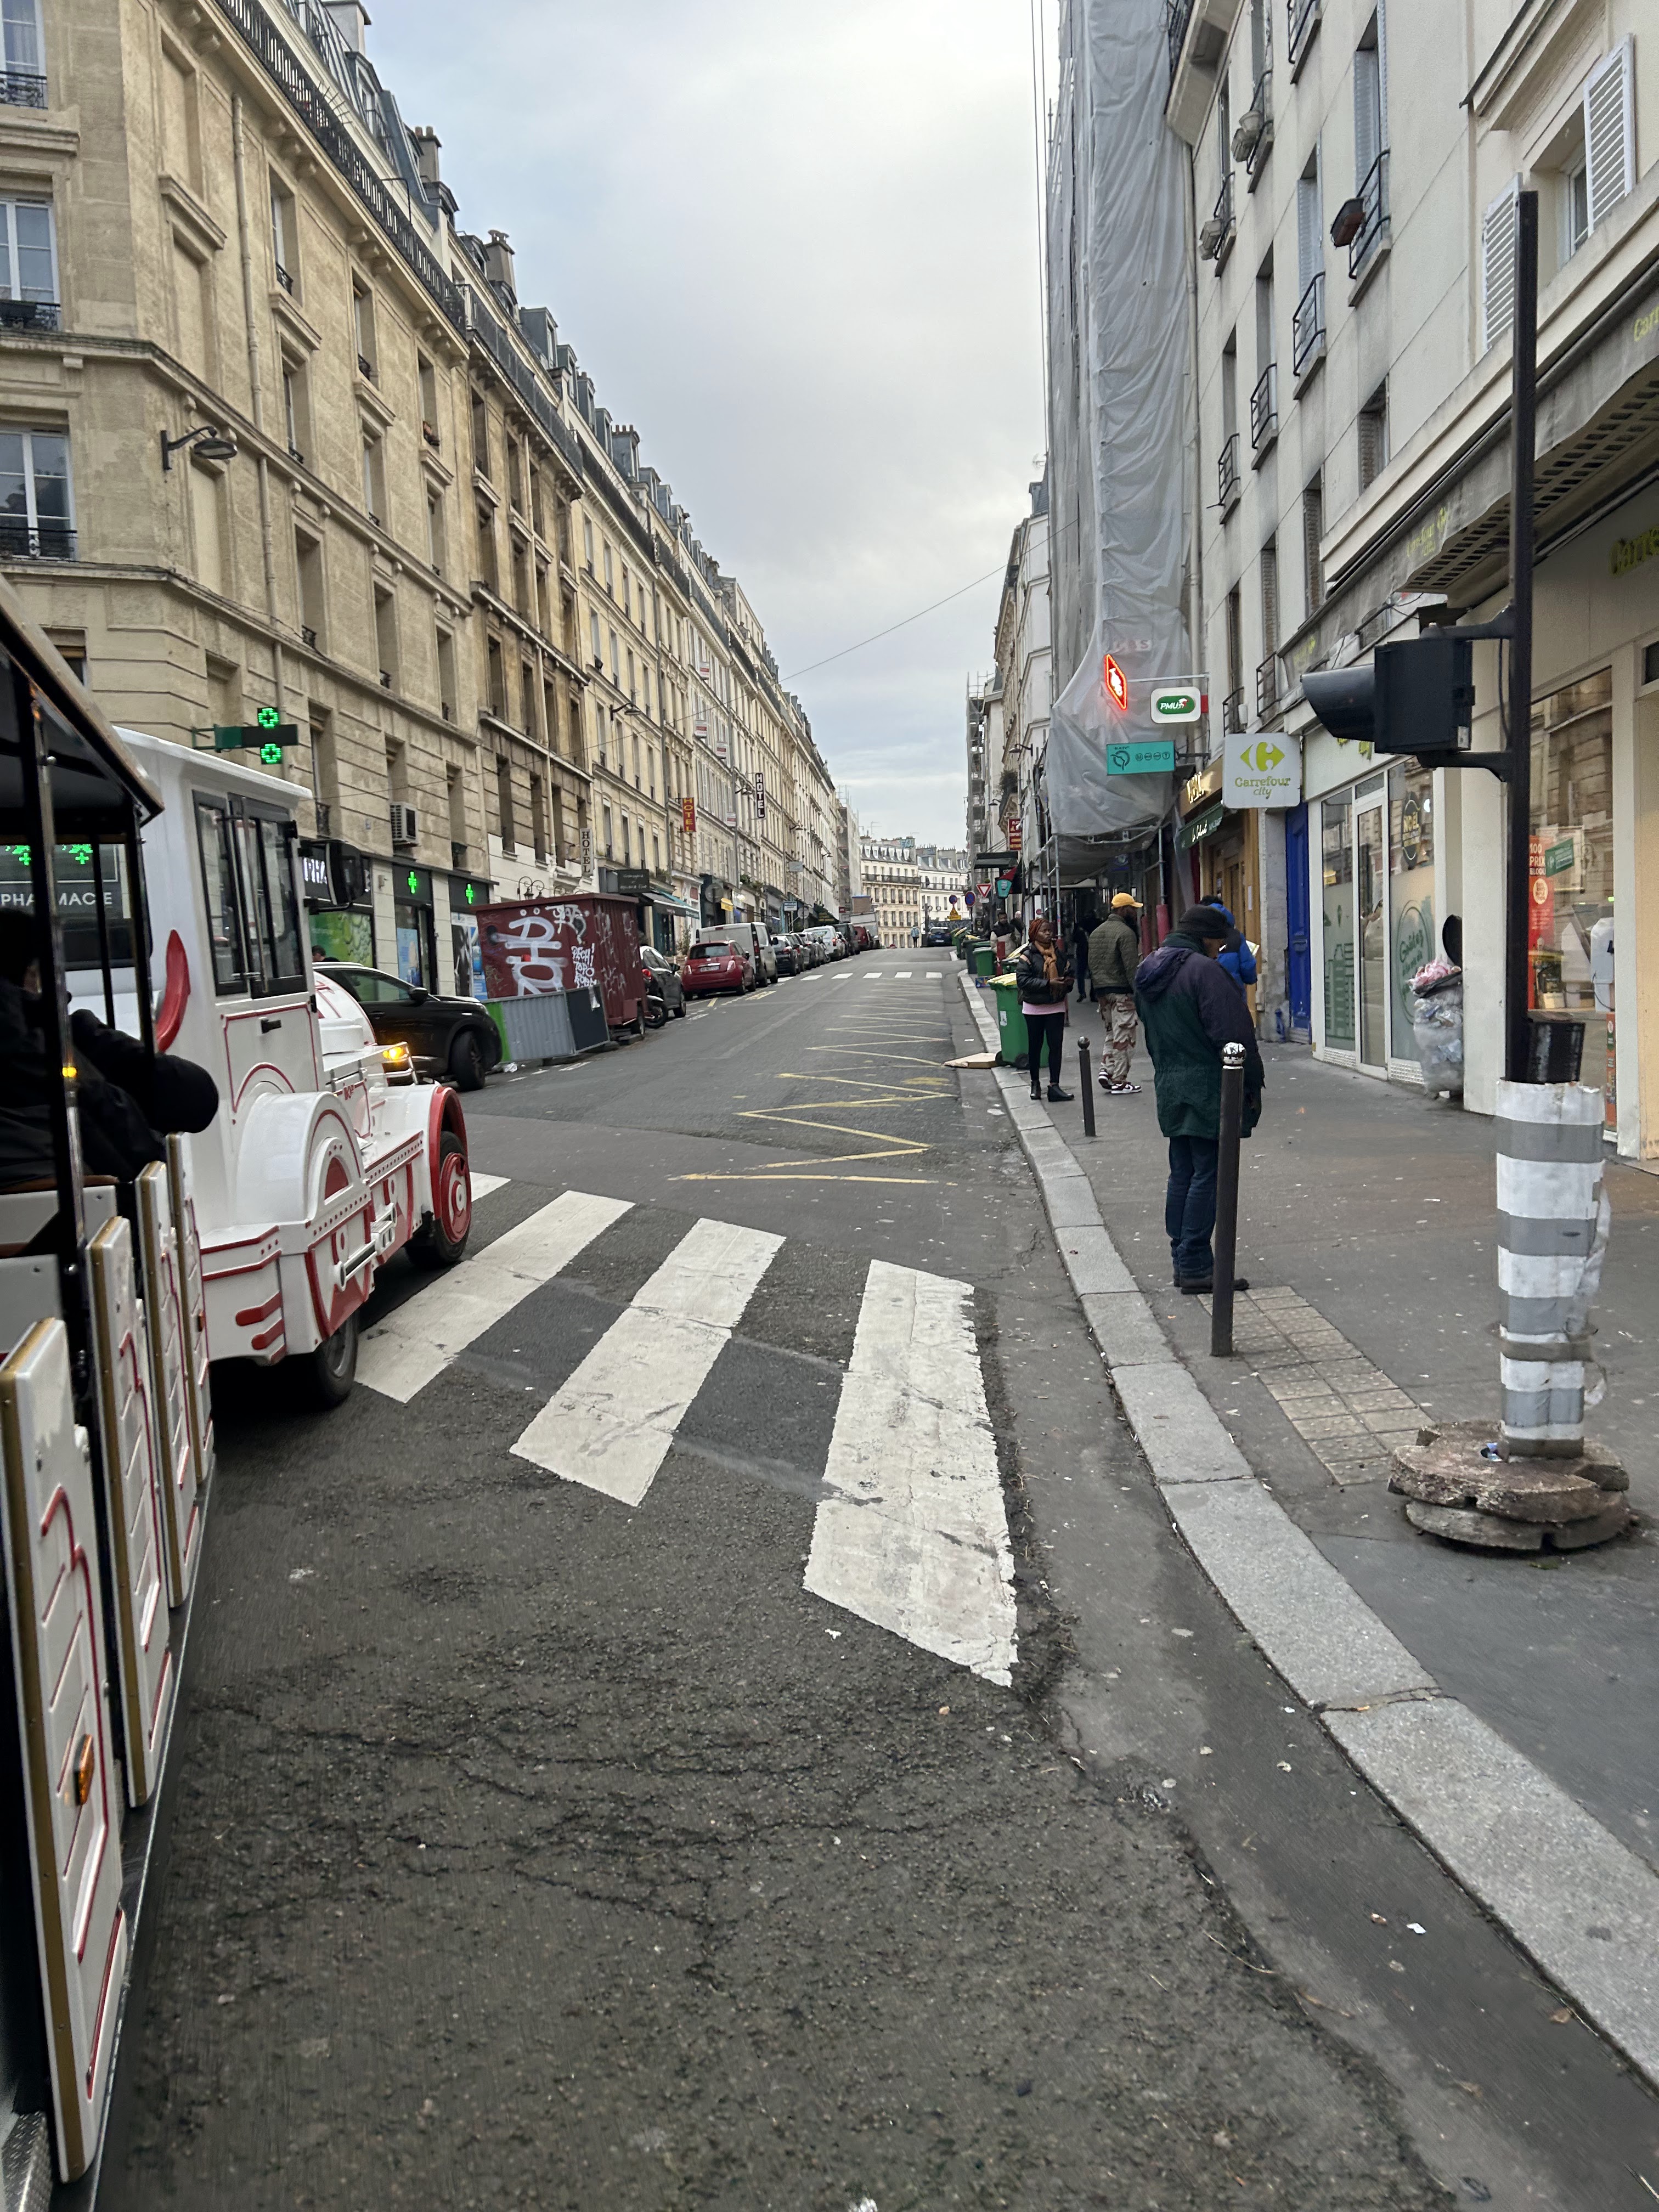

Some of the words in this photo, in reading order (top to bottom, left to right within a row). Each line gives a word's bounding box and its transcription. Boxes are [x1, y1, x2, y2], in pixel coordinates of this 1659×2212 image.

[1234, 776, 1291, 787] Carrefour
[756, 774, 765, 818] HOTEL
[1253, 787, 1272, 799] city
[684, 798, 694, 832] HOTEL
[582, 831, 590, 873] HOTEL
[1530, 856, 1545, 867] PRIX
[1, 892, 112, 906] PHAMACE
